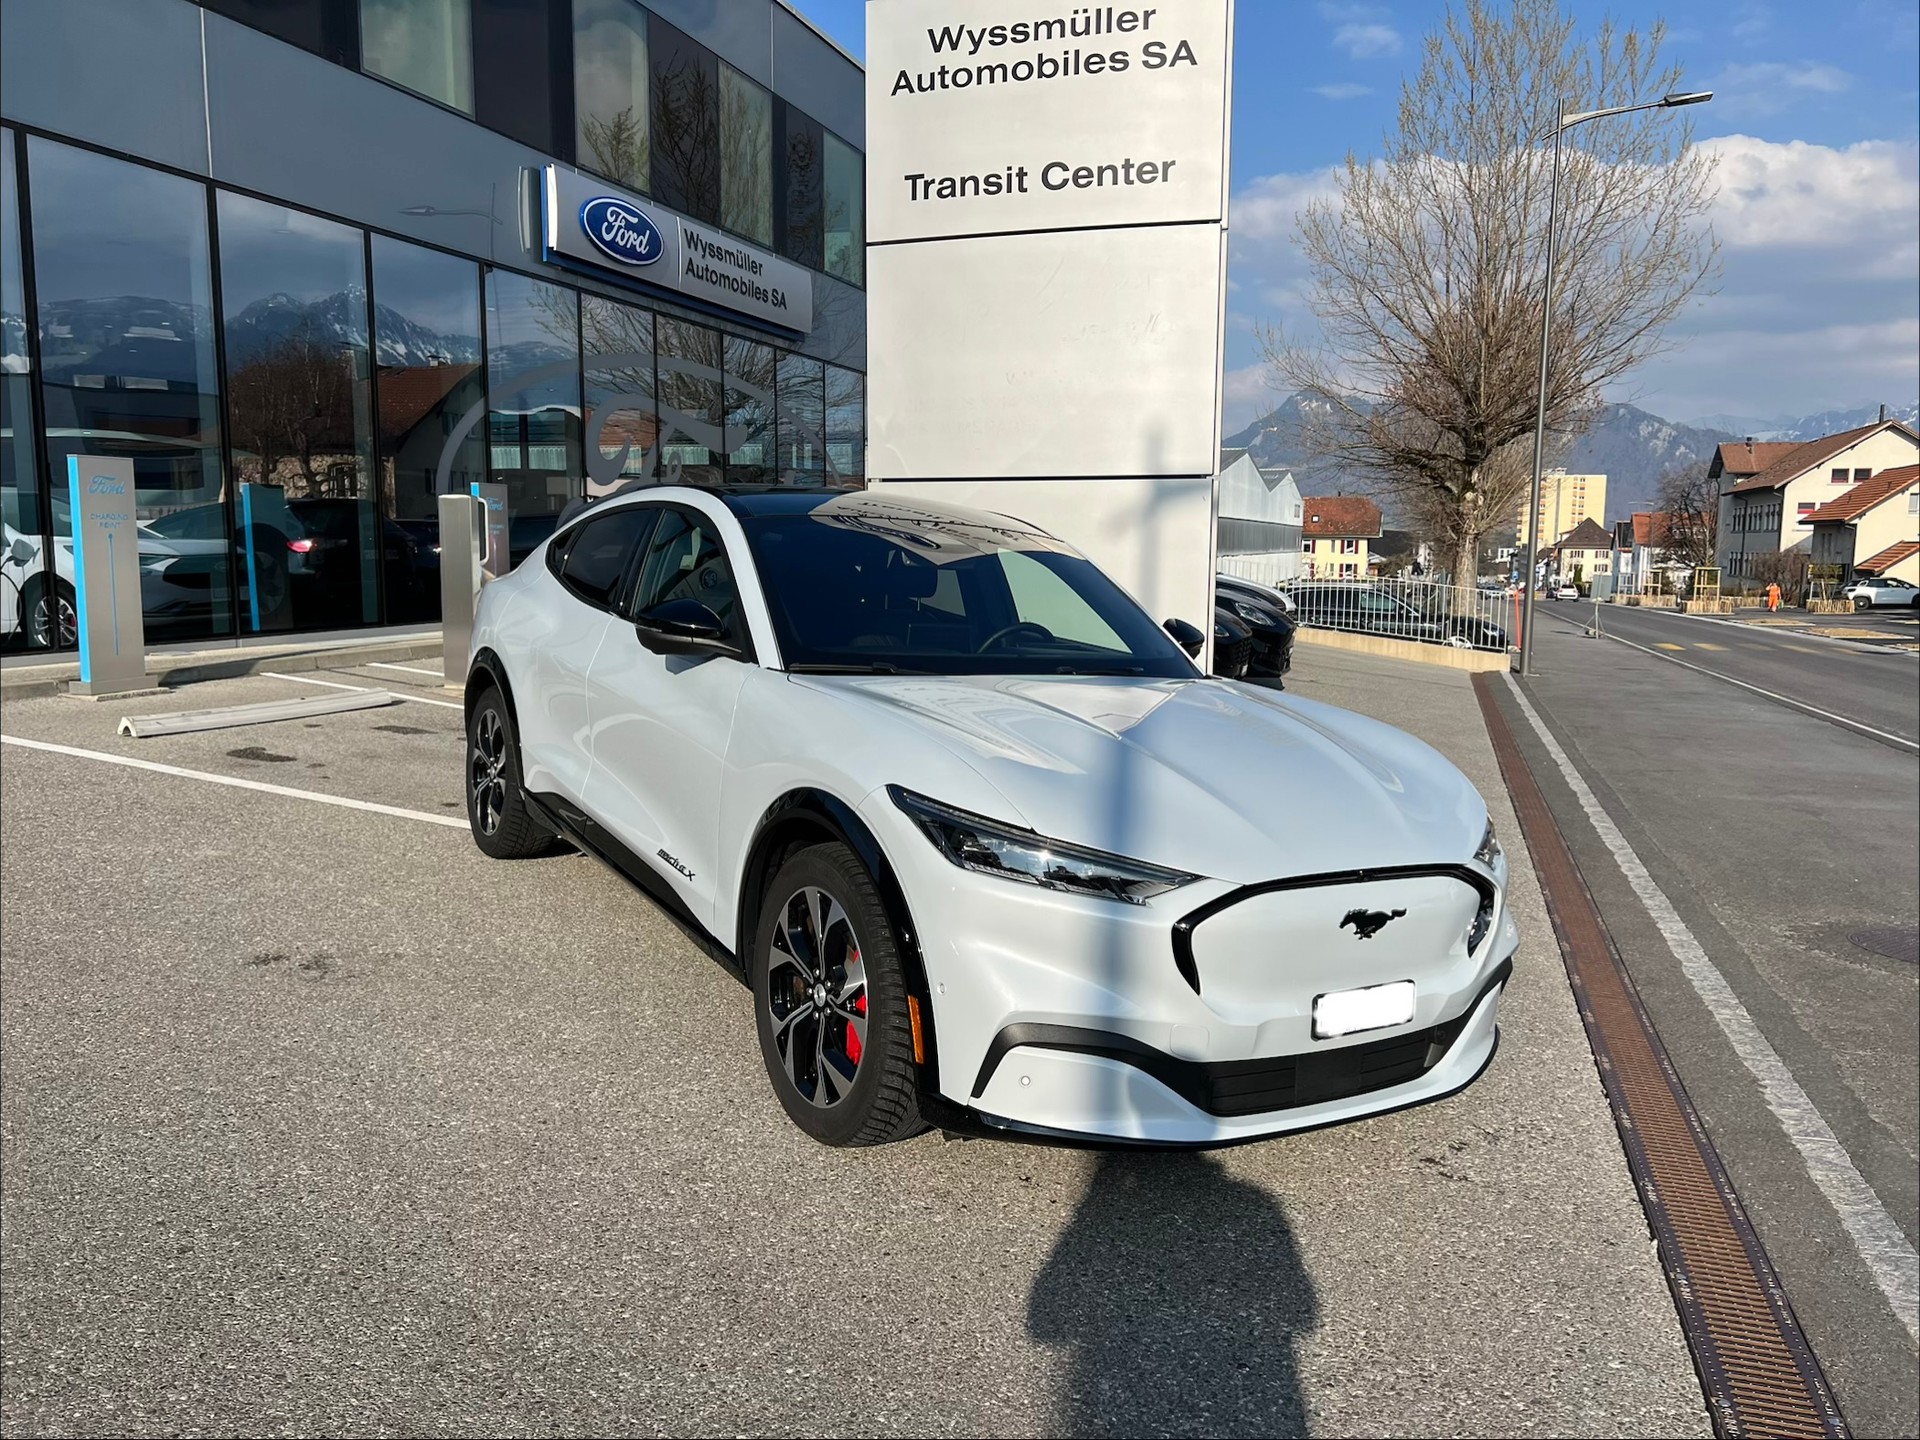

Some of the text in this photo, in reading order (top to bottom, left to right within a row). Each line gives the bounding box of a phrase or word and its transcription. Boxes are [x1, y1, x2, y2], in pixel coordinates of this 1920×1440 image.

[927, 7, 1157, 56] Wyssmüller
[890, 39, 1198, 96] Automobiles SA
[904, 158, 1176, 201] Transit Center
[601, 206, 650, 255] Ford
[683, 228, 763, 276] Wyssmüller
[685, 257, 788, 311] Automobiles SA
[88, 475, 126, 495] Ford
